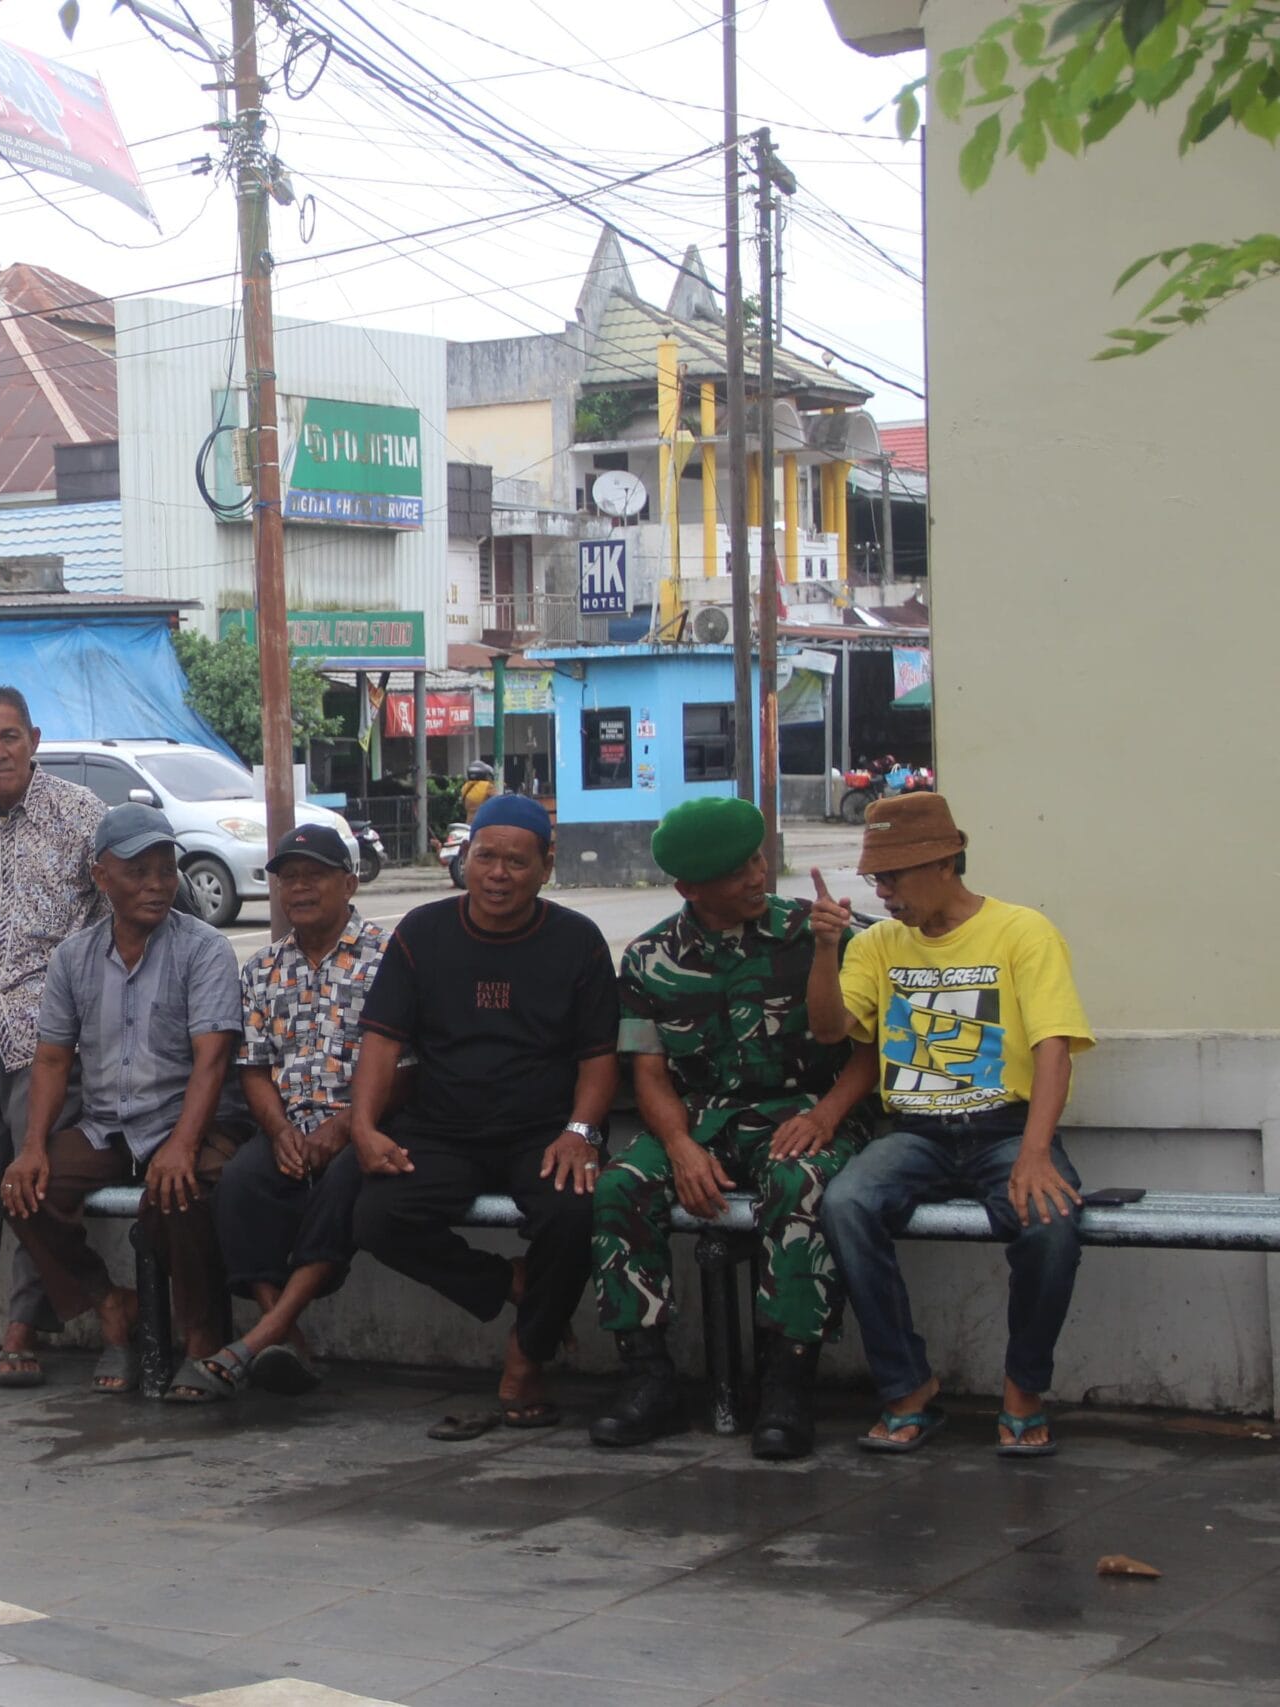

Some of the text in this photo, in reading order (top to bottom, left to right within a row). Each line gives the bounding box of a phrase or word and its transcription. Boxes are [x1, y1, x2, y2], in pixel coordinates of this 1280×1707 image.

[582, 545, 625, 594] HK
[582, 597, 623, 609] HOTEL
[888, 966, 998, 988] ULTRAS GRESIK
